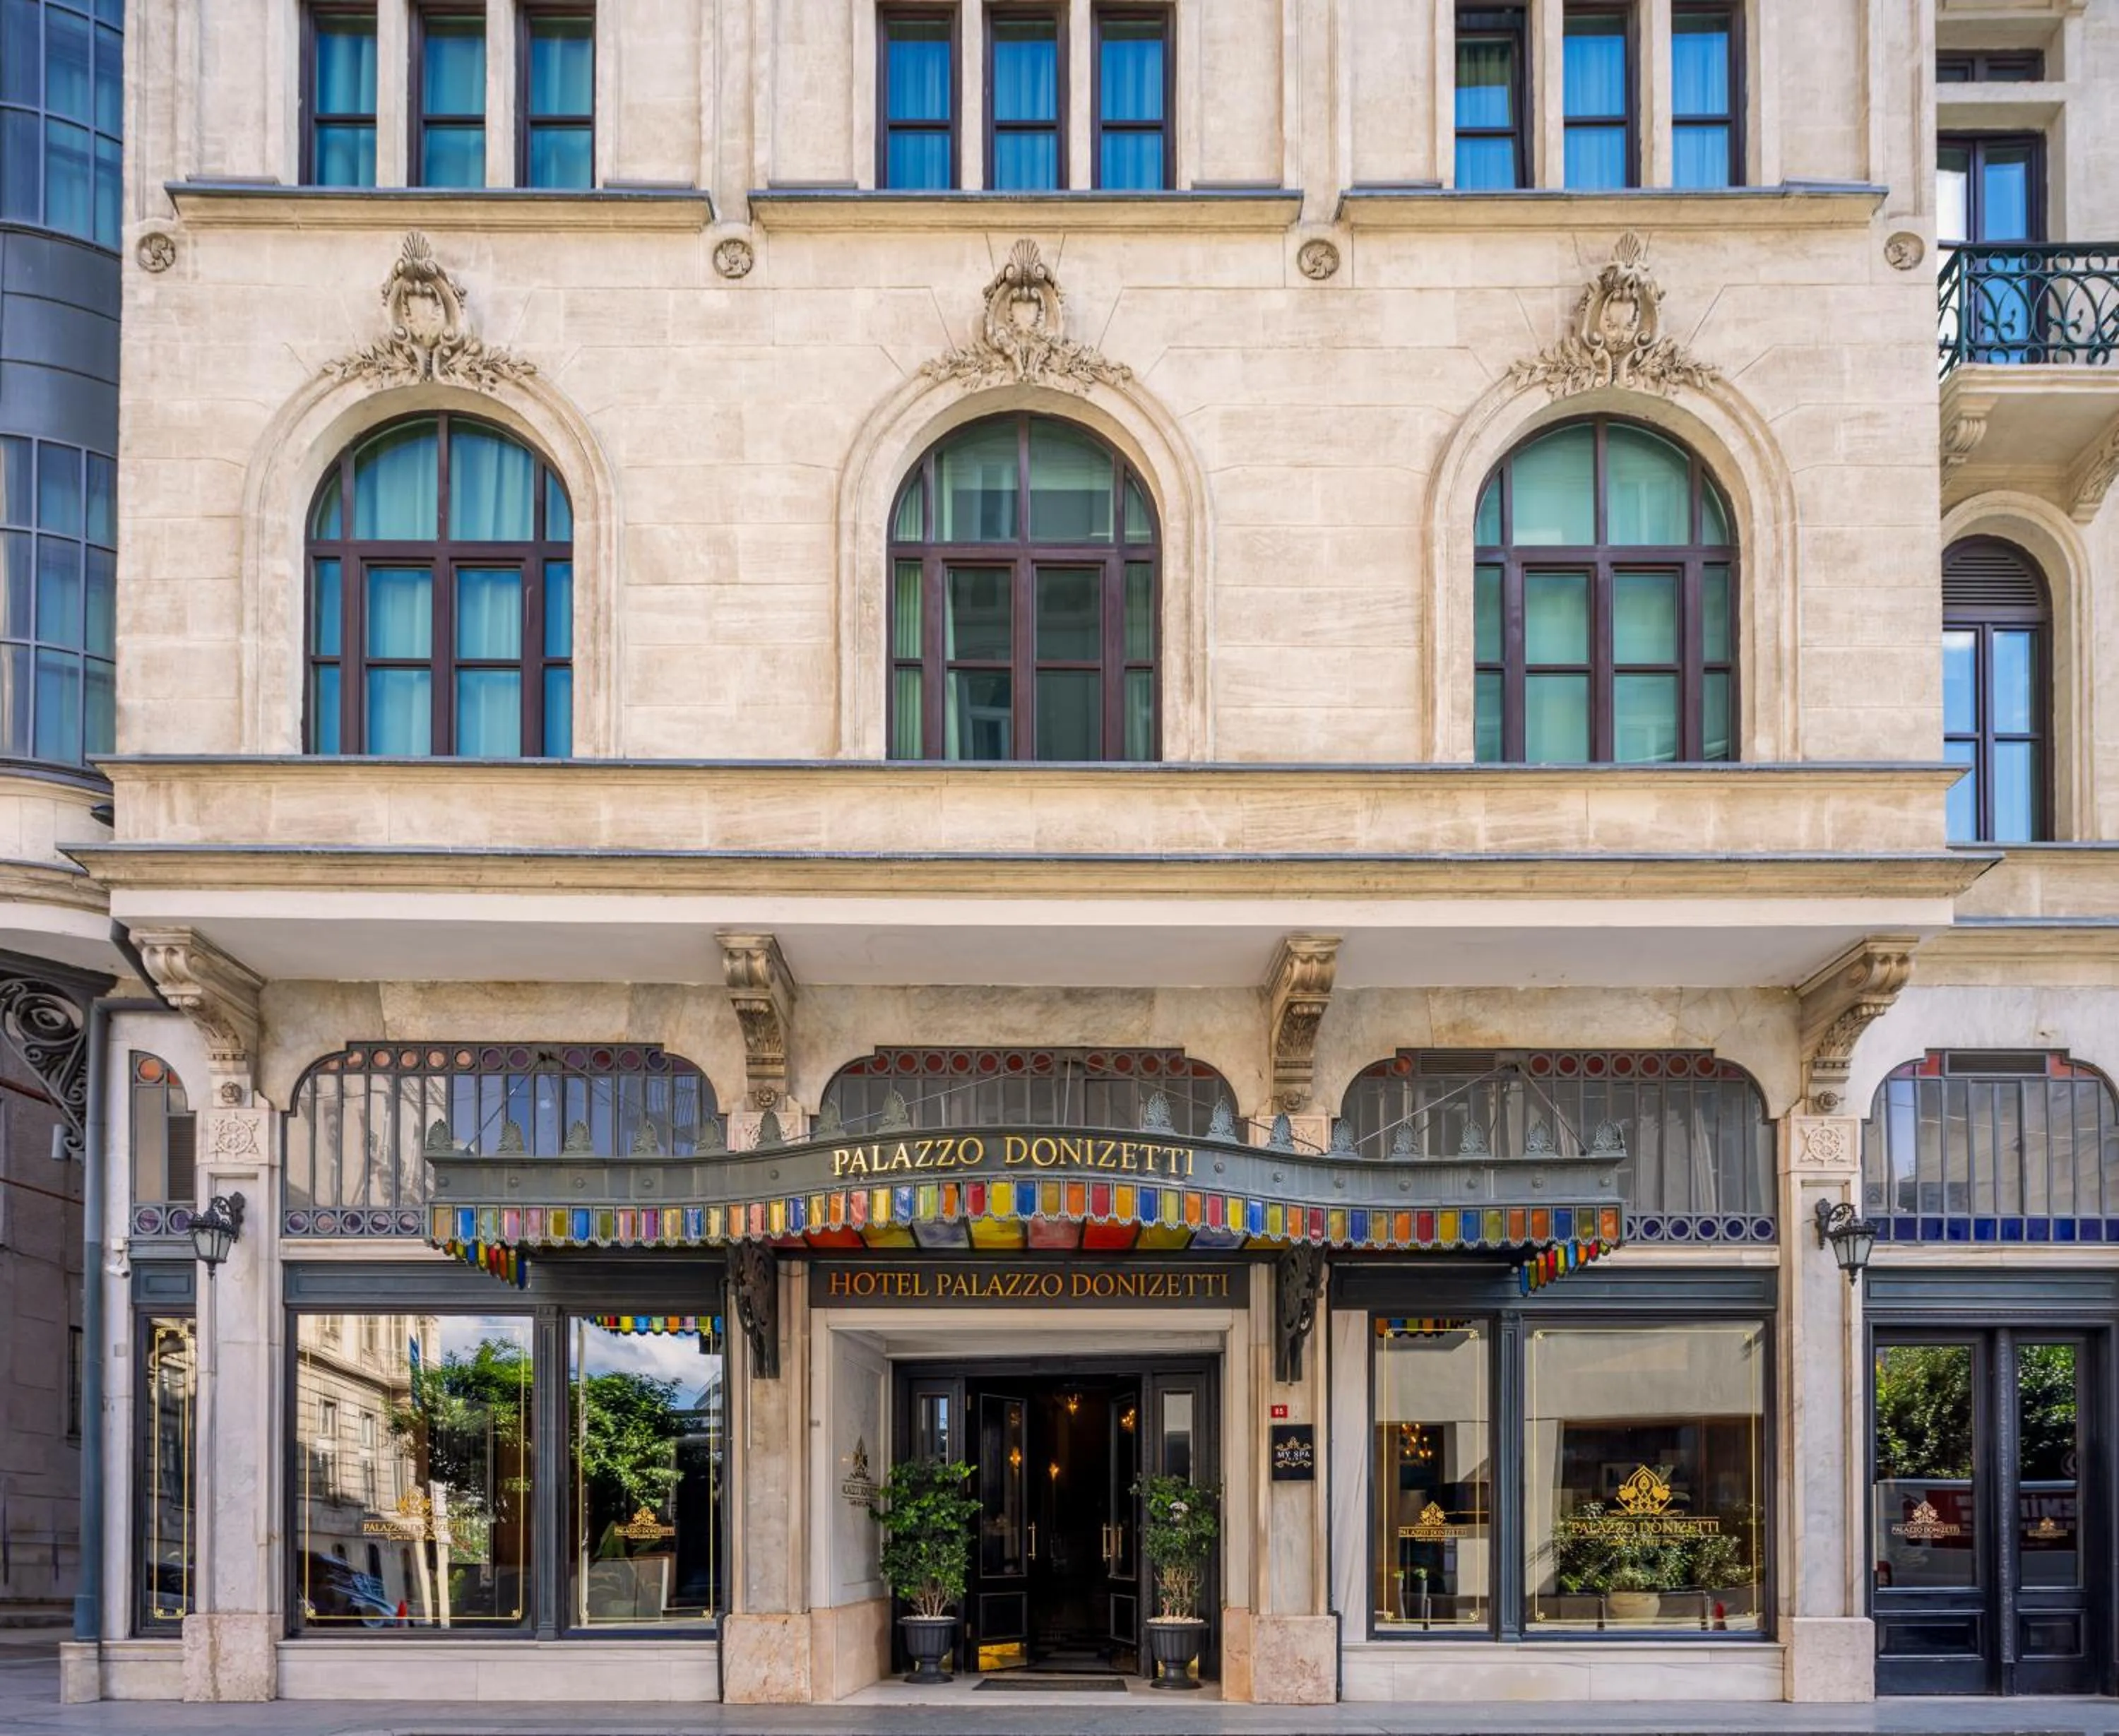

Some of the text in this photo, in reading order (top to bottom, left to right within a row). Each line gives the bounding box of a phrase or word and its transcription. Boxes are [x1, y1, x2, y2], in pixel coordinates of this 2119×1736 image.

[833, 1136, 1194, 1176] PALAZZO DONIZETTI
[829, 1272, 1229, 1298] HOTEL PALAZZO DONIZETTI
[1572, 1521, 1719, 1533] PALAZZO DONIZETTI
